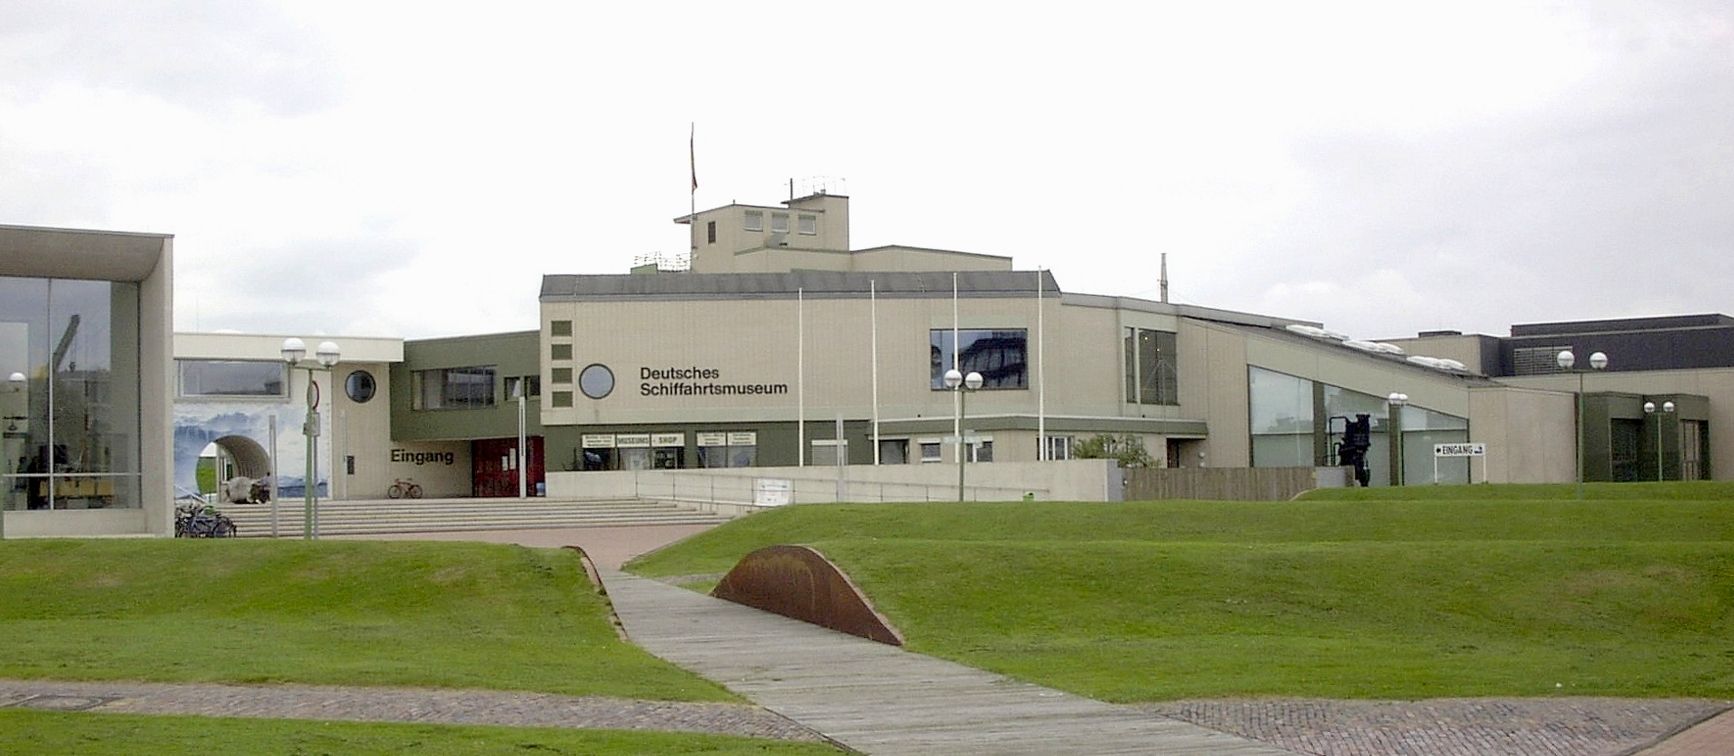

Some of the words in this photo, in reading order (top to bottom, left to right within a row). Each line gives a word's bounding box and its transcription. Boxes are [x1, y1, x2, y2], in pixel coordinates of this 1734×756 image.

[640, 367, 719, 380] Deutsches
[640, 382, 788, 396] Schiffahrtsmuseum
[658, 436, 677, 444] SHOP
[1442, 445, 1473, 454] EINGANG
[391, 449, 454, 464] Eingang
